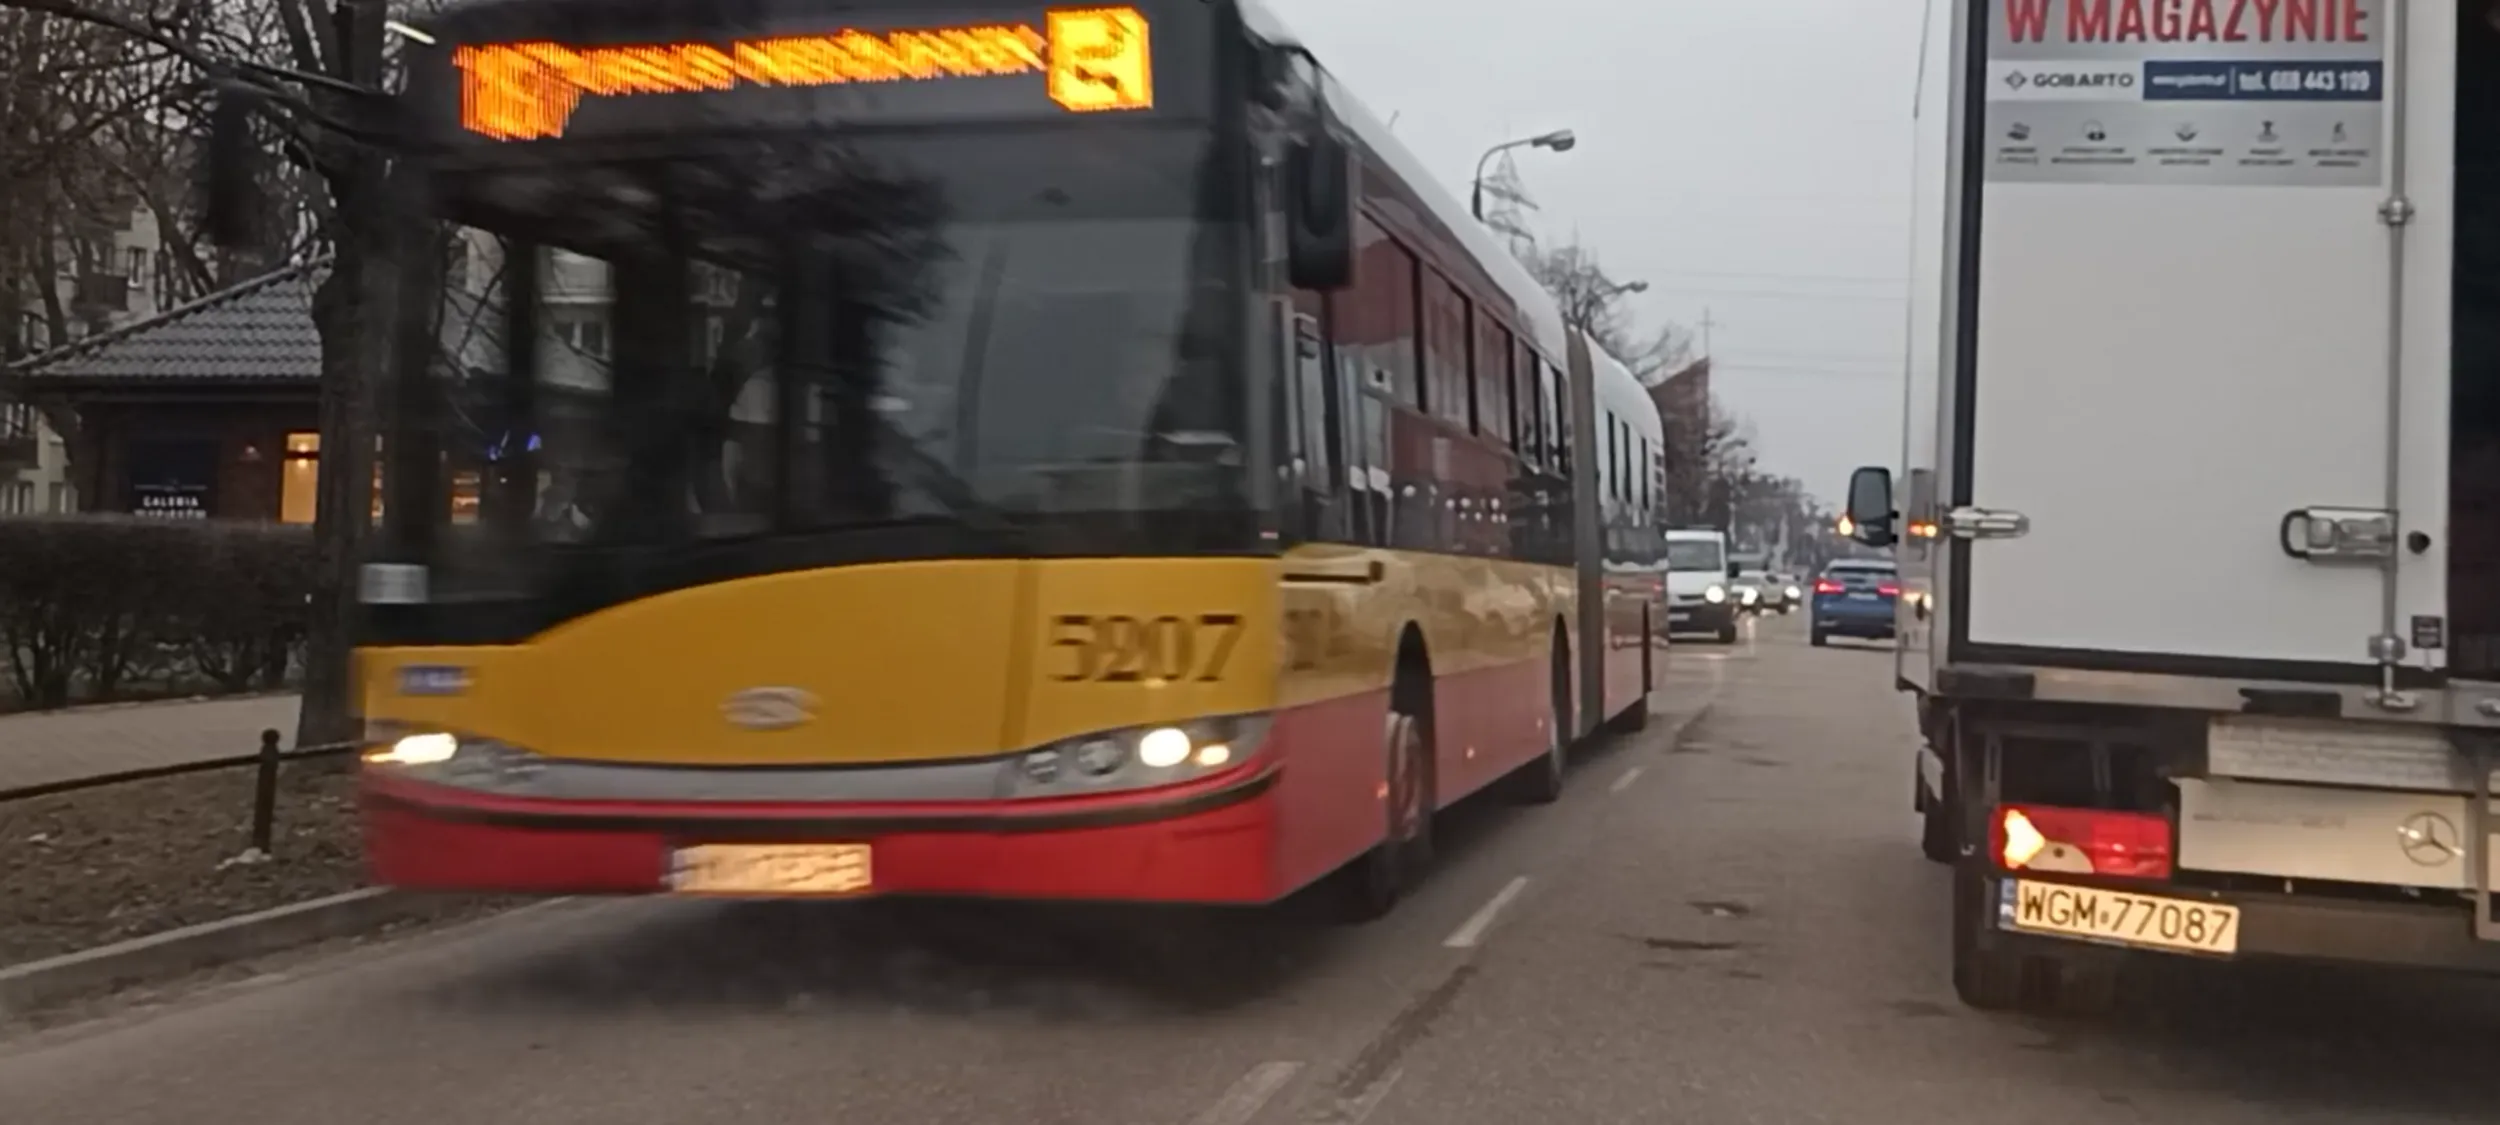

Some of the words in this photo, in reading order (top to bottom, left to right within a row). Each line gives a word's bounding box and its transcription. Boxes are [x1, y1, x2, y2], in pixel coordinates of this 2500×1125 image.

[2004, 0, 2048, 42] W
[2066, 0, 2368, 42] MAGAZYNIE
[2033, 73, 2134, 88] GOBARTO
[1050, 613, 1246, 682] 5207
[2023, 886, 2097, 929] WGM
[2111, 897, 2232, 946] 77087
